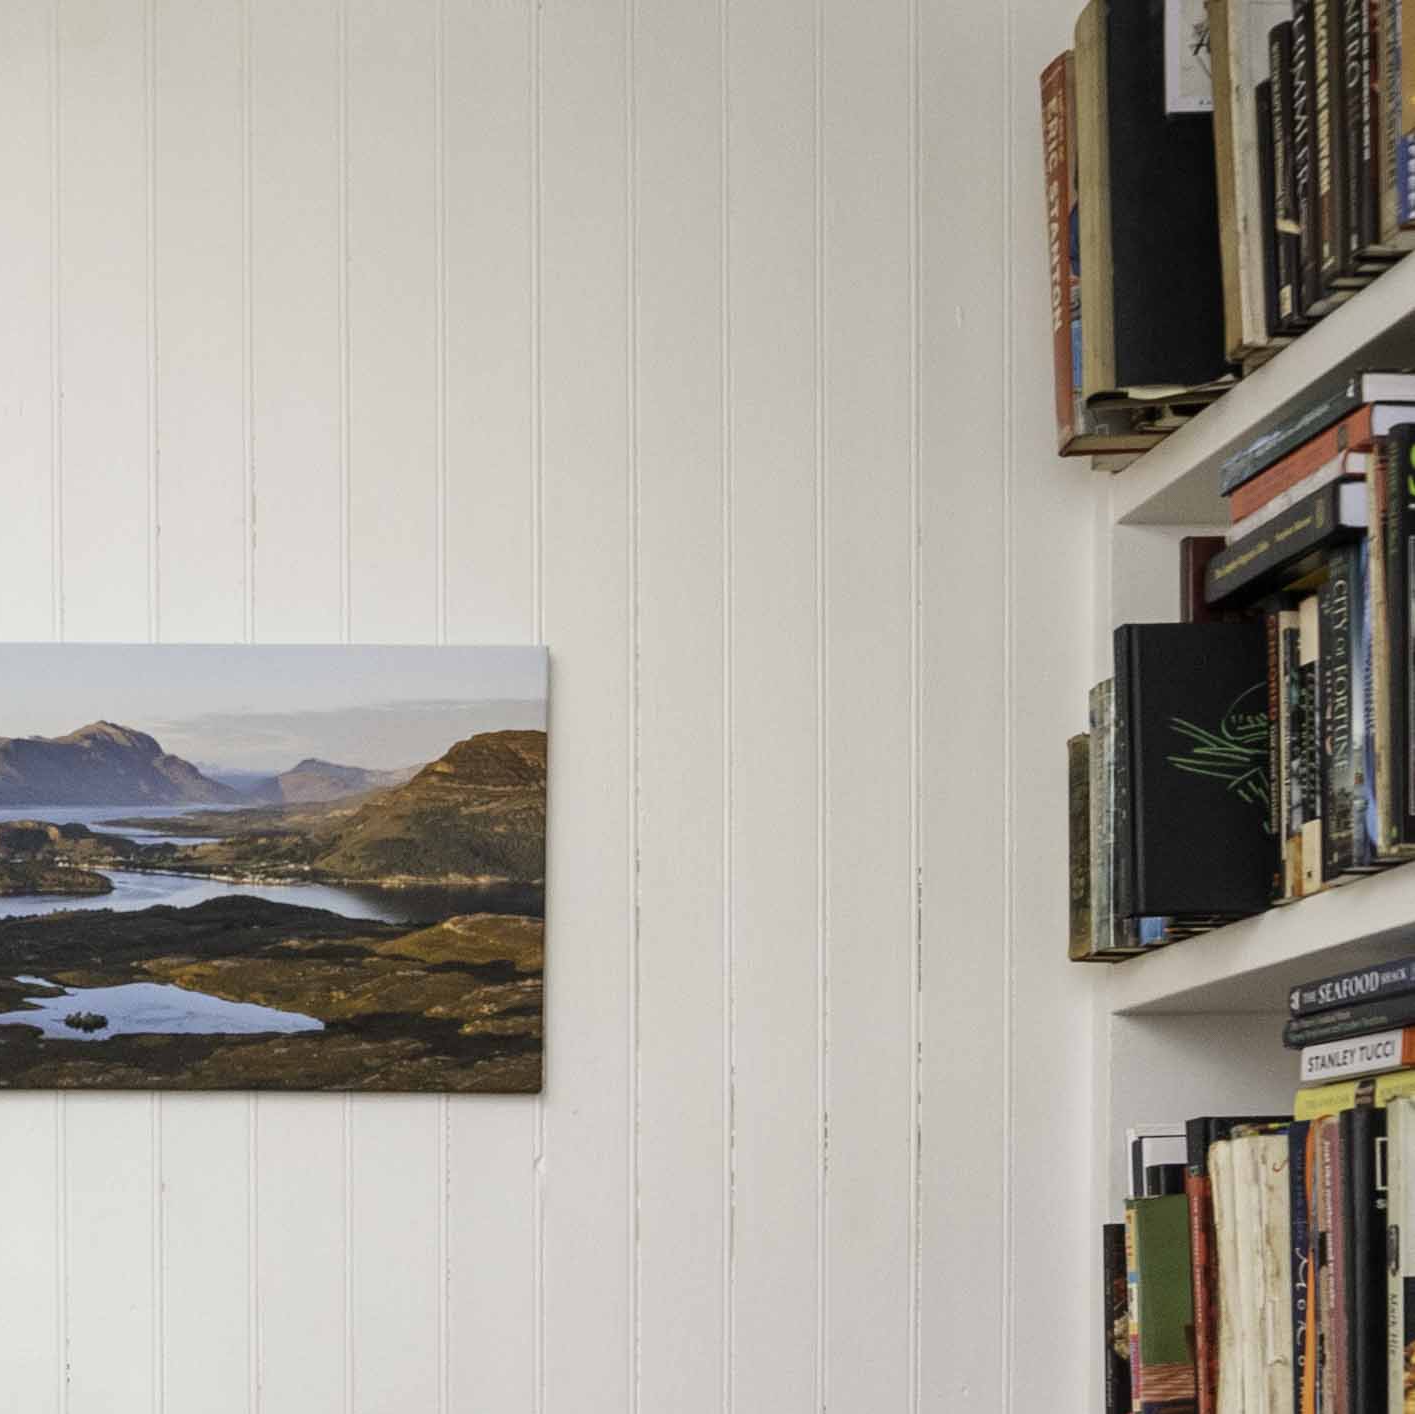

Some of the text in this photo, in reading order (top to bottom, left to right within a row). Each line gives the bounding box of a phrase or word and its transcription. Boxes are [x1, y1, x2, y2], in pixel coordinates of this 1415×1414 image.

[1044, 97, 1062, 332] ERIC STANTON
[1333, 579, 1348, 631] CITY
[1334, 665, 1350, 769] FORTUNE
[1318, 971, 1379, 1004] SEAFOOD
[1308, 1040, 1395, 1073] STANLEY TUCCI
